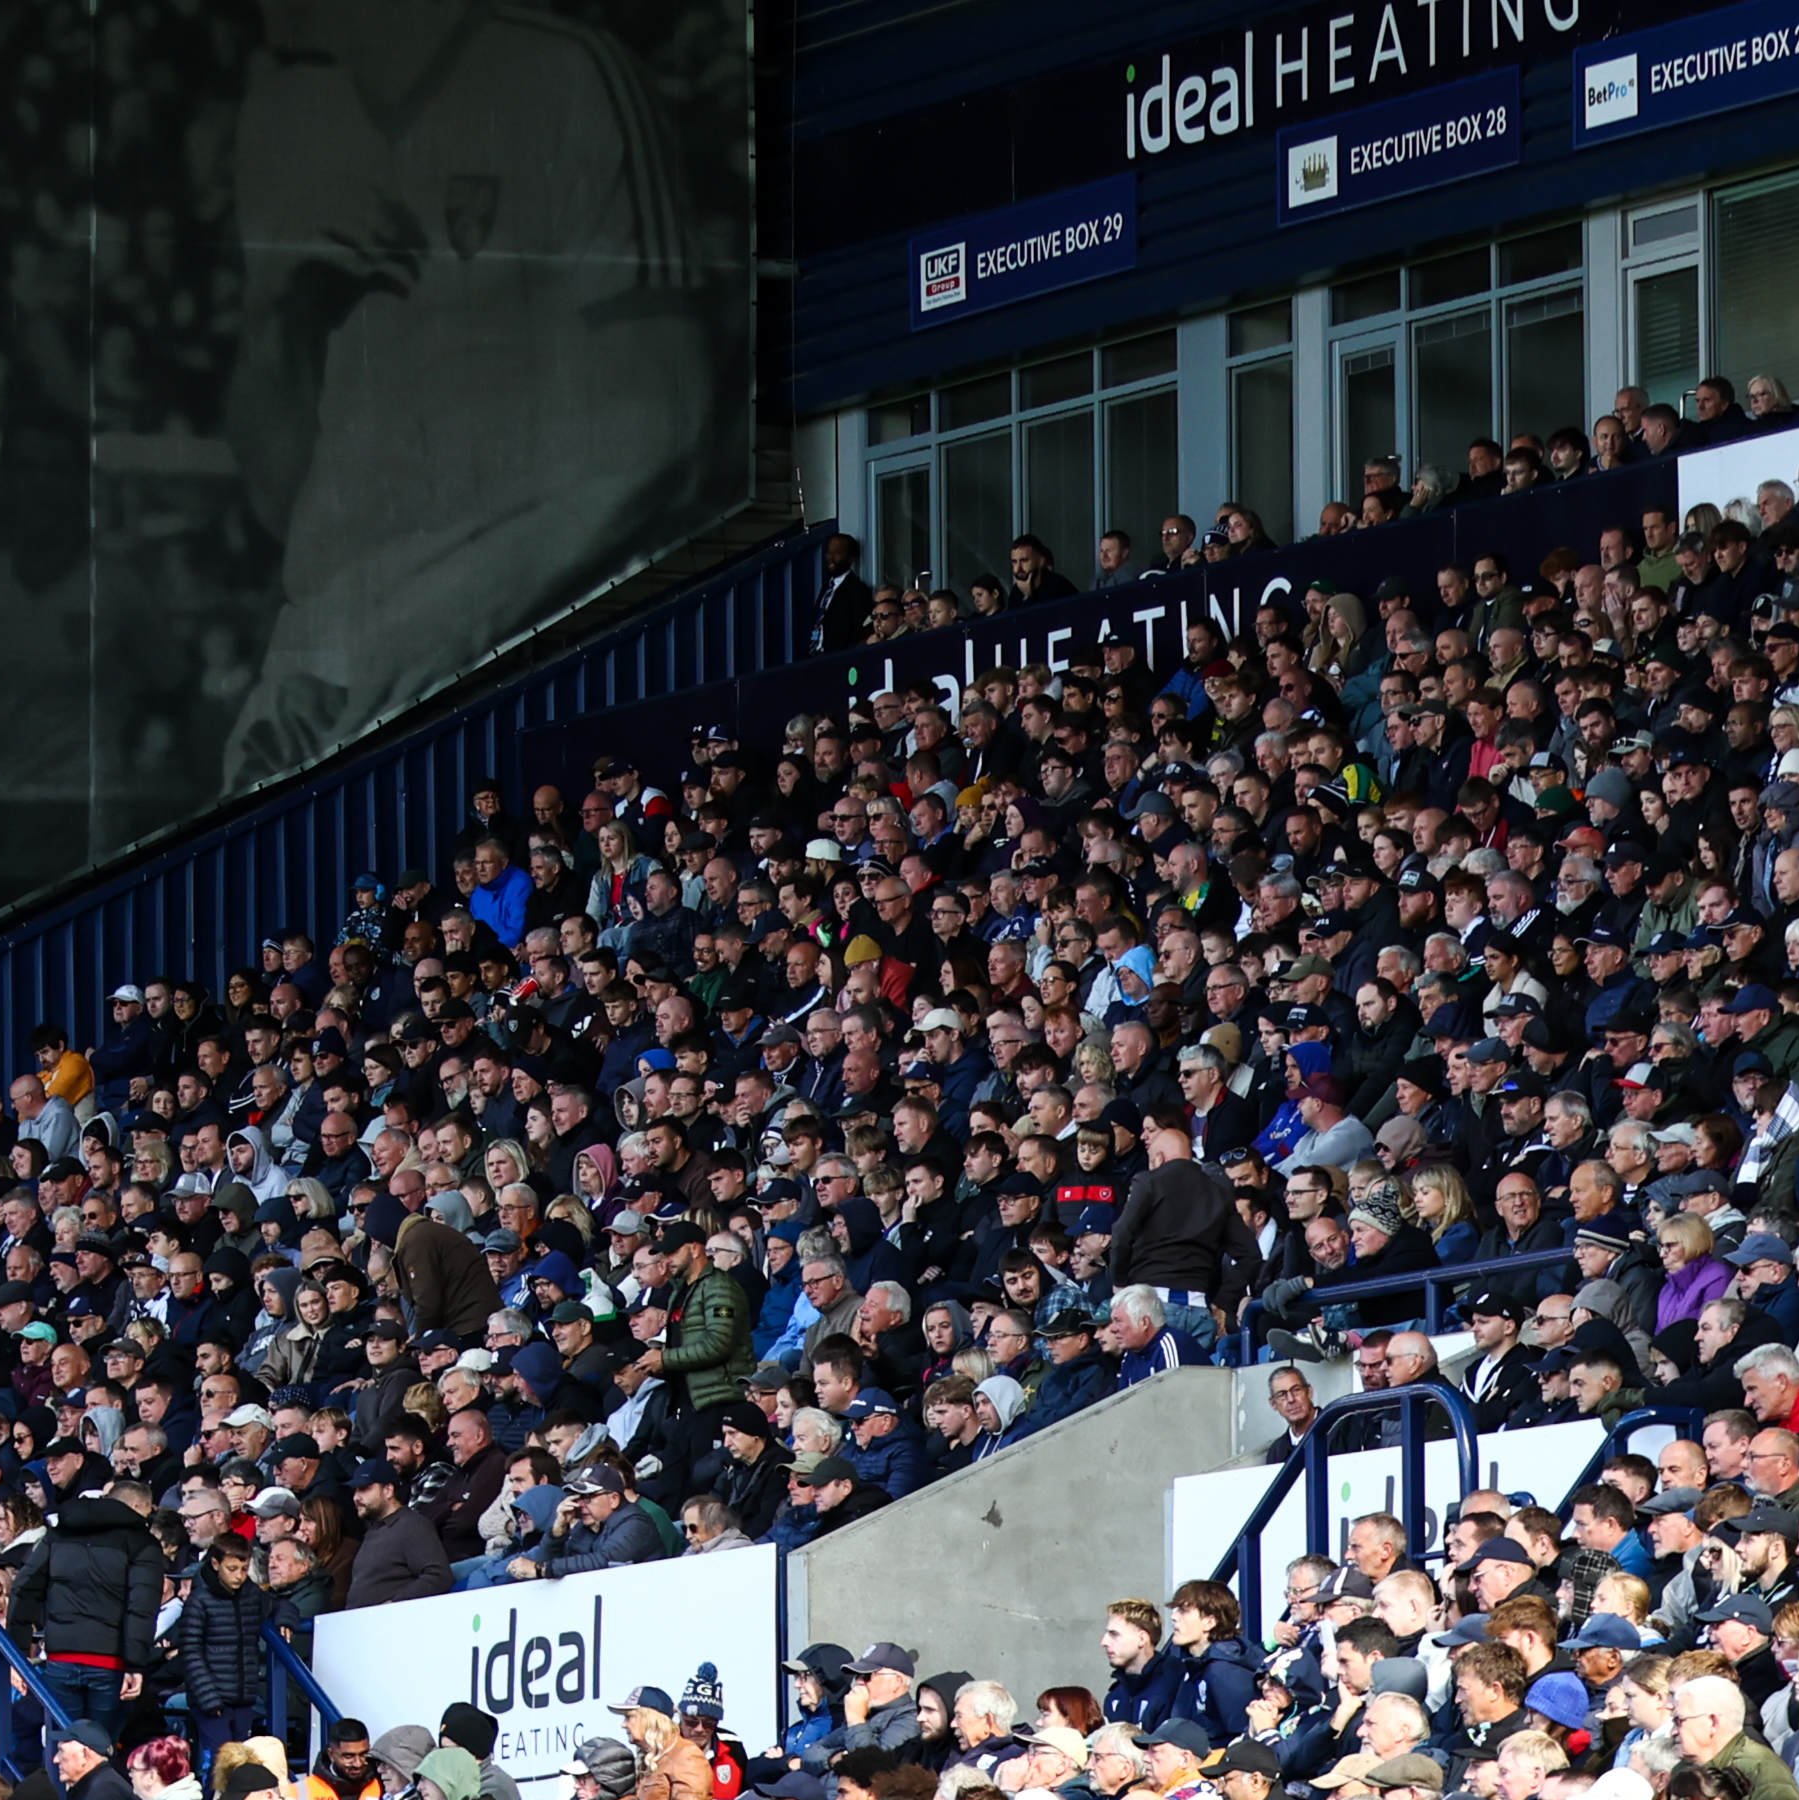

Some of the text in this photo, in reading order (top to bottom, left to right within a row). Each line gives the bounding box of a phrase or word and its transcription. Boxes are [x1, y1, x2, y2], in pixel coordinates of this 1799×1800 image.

[1588, 80, 1628, 107] BetPro
[1651, 40, 1747, 94] EXECUTIVE
[1752, 28, 1790, 67] BOX
[1126, 30, 1253, 159] ideal
[1350, 106, 1507, 175] EXECUTIVE BOX 28
[927, 252, 959, 279] UKF
[977, 212, 1123, 280] EXECUTIVE BOX 29
[931, 279, 957, 295] Group
[471, 1594, 602, 1713] ideal
[498, 1722, 586, 1758] EATING
